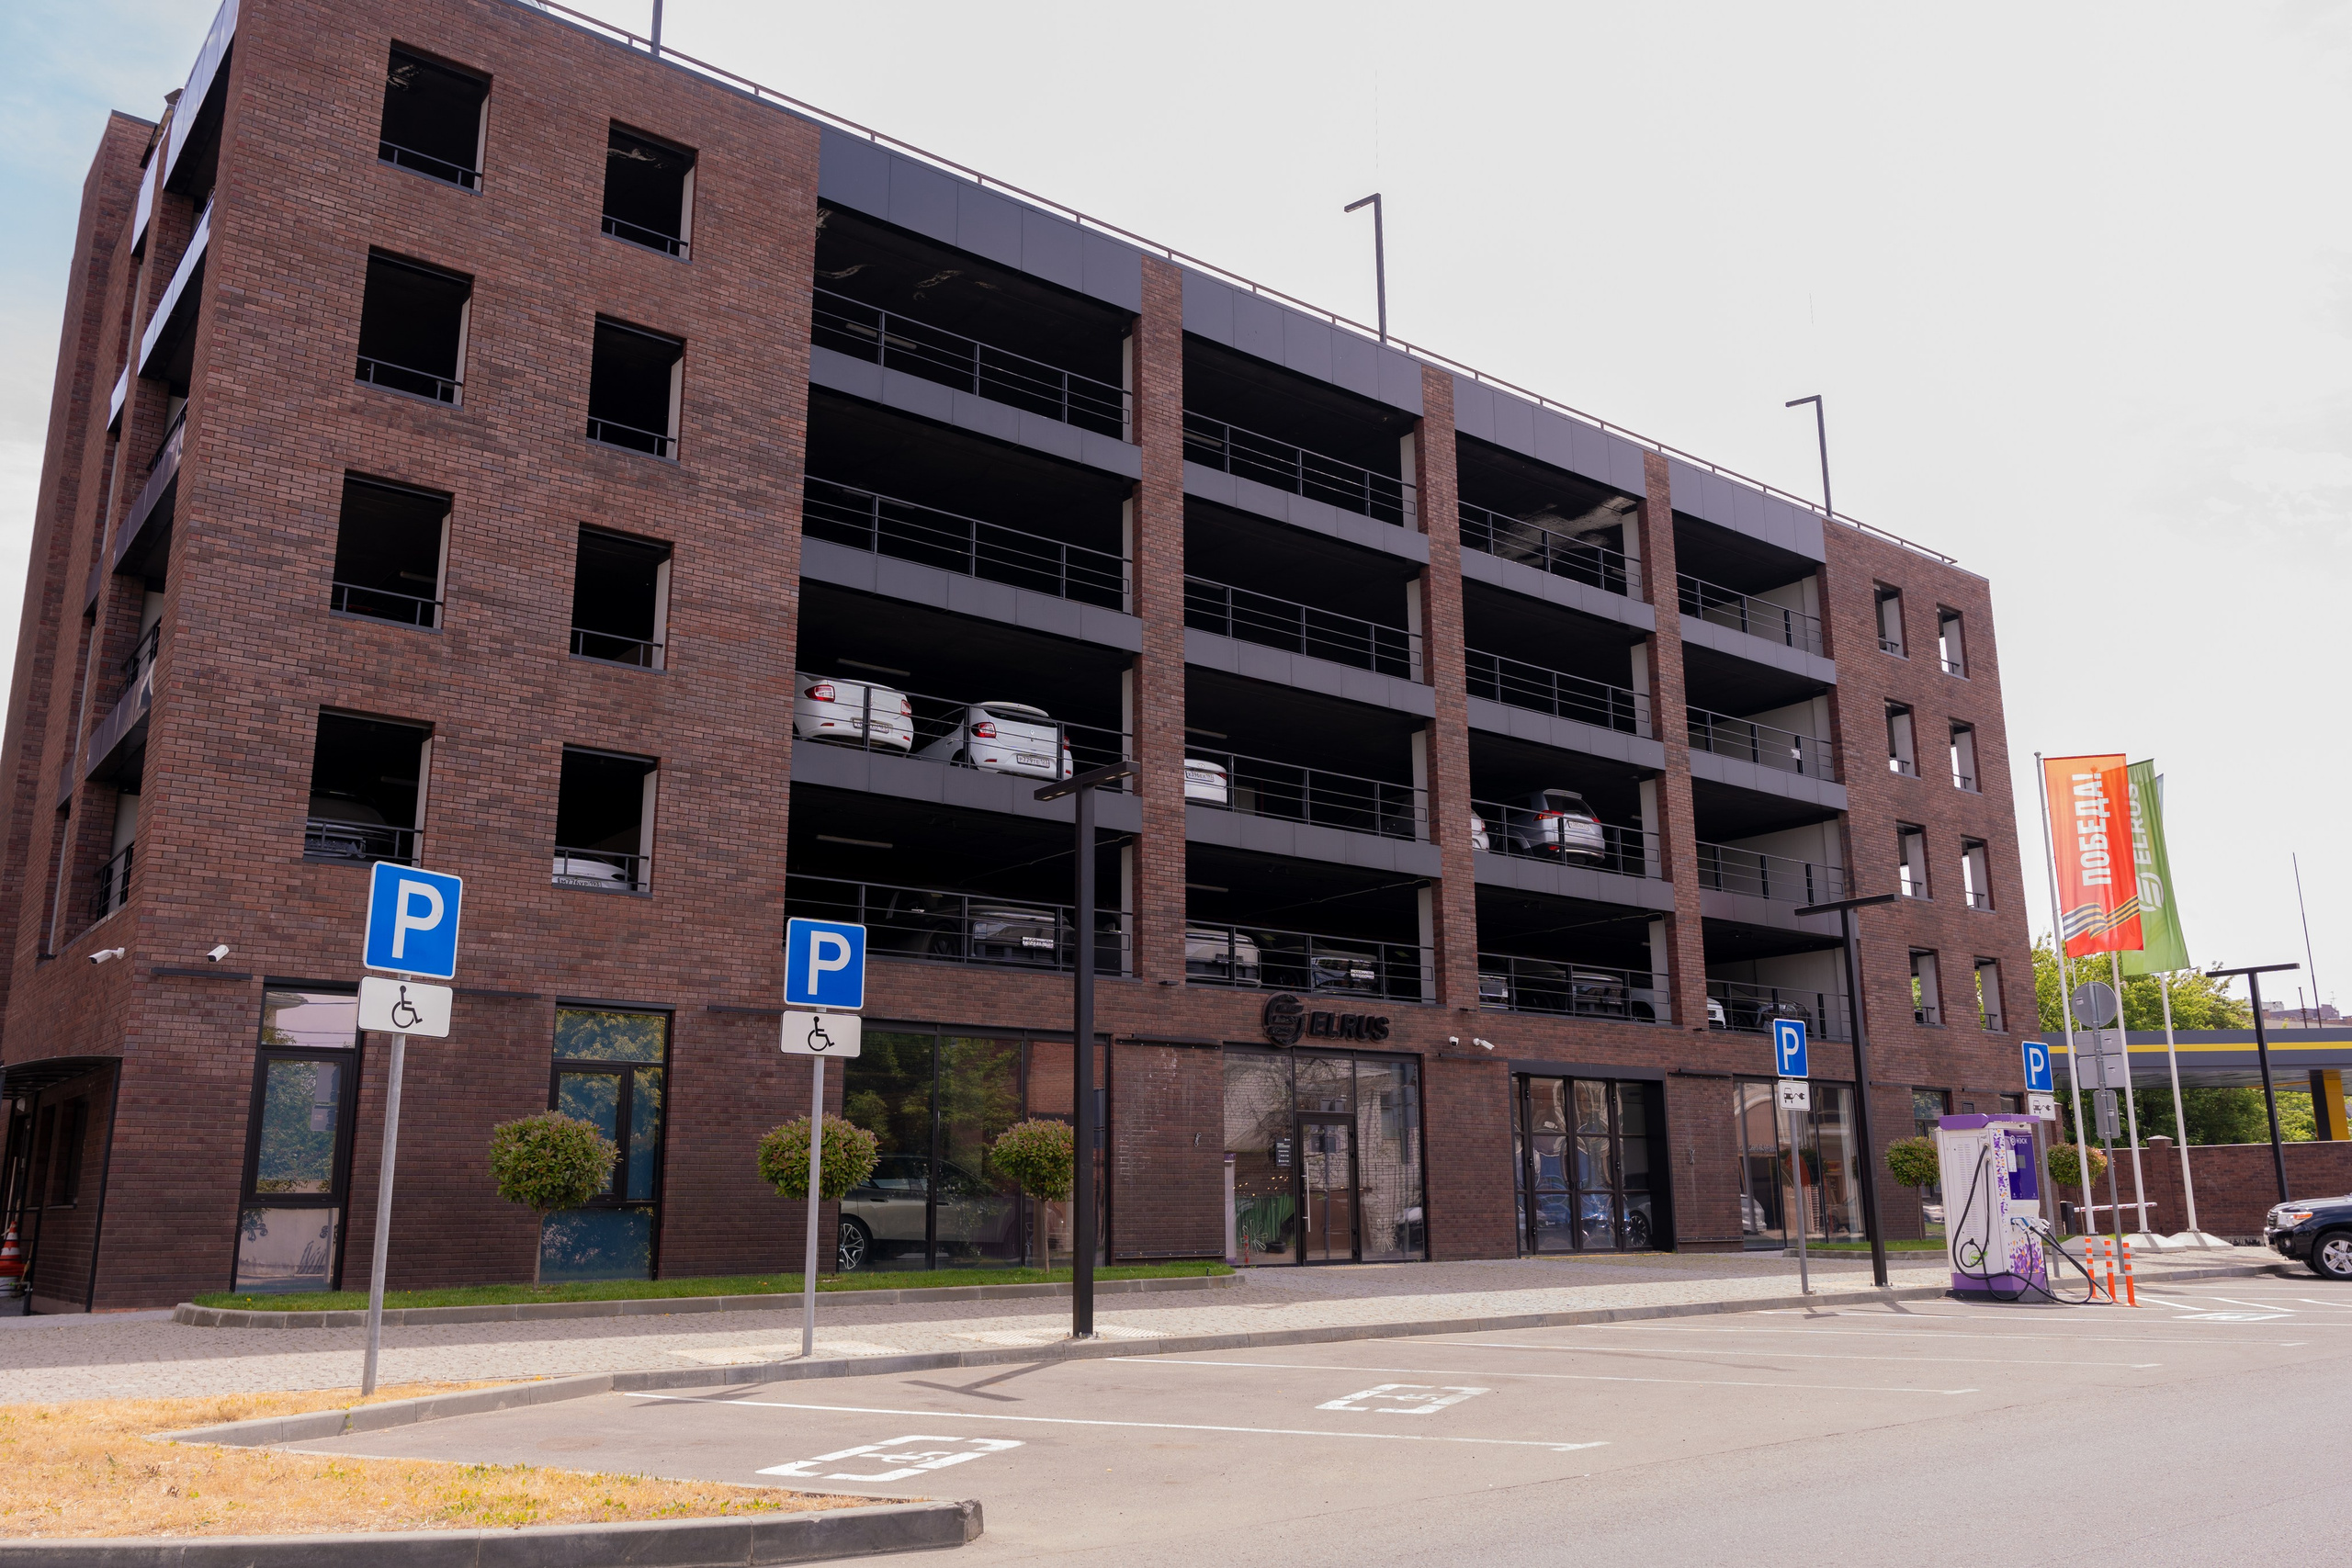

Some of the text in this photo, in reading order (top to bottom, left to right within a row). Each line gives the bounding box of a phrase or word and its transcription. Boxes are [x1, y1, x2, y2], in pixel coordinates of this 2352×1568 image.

[2071, 773, 2111, 886] ПОБЕДА!
[391, 878, 445, 959] P
[808, 930, 852, 996] P
[1307, 1010, 1390, 1043] ELRUS
[1781, 1026, 1800, 1070] P
[2029, 1047, 2045, 1085] P
